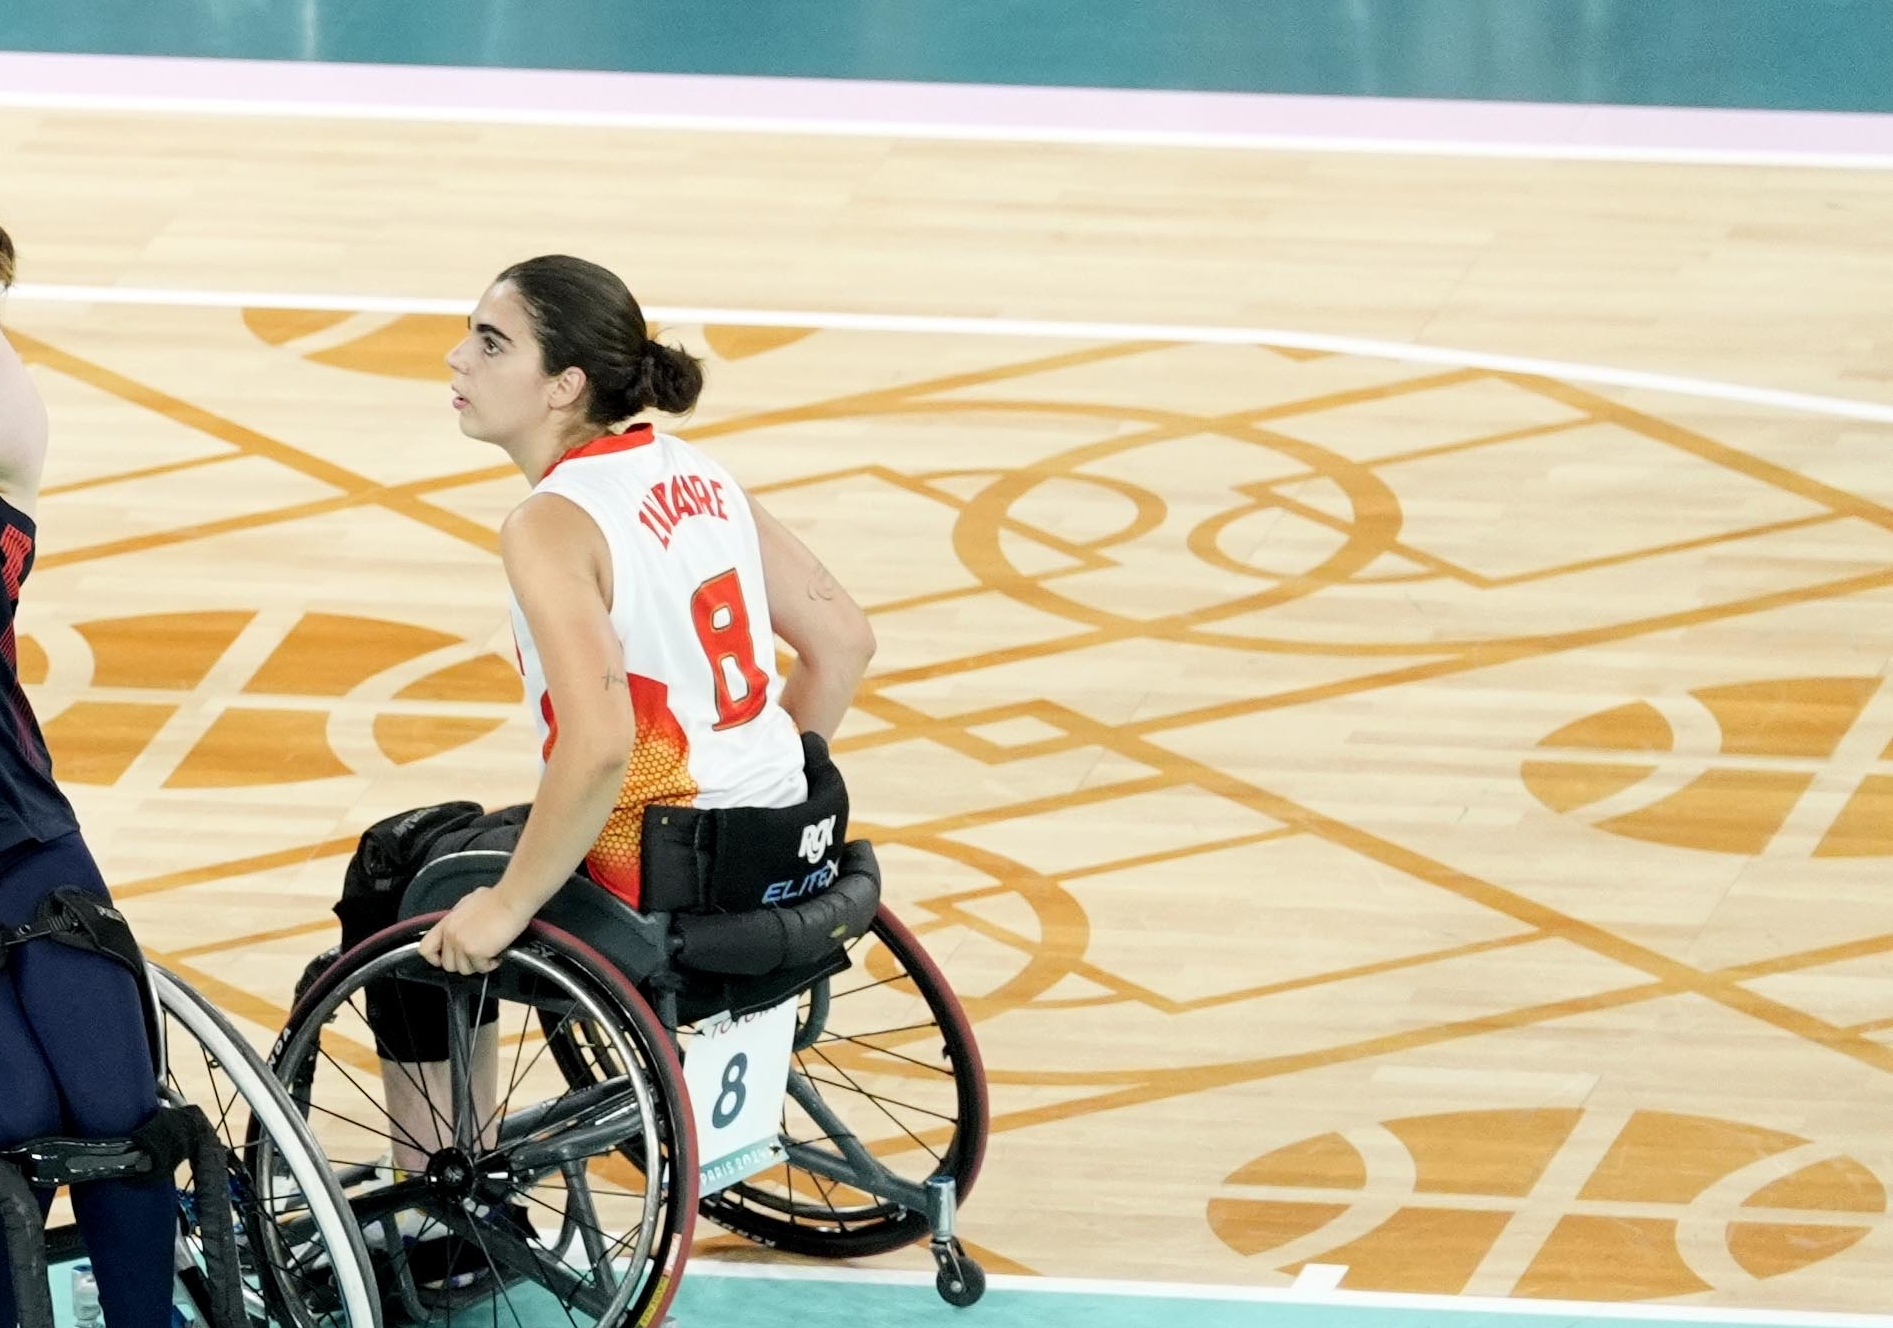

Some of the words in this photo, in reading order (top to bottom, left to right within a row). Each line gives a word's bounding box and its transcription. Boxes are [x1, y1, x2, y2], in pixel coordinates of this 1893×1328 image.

[690, 566, 770, 732] 8
[712, 1052, 748, 1129] 8
[700, 1162, 734, 1186] PARIS
